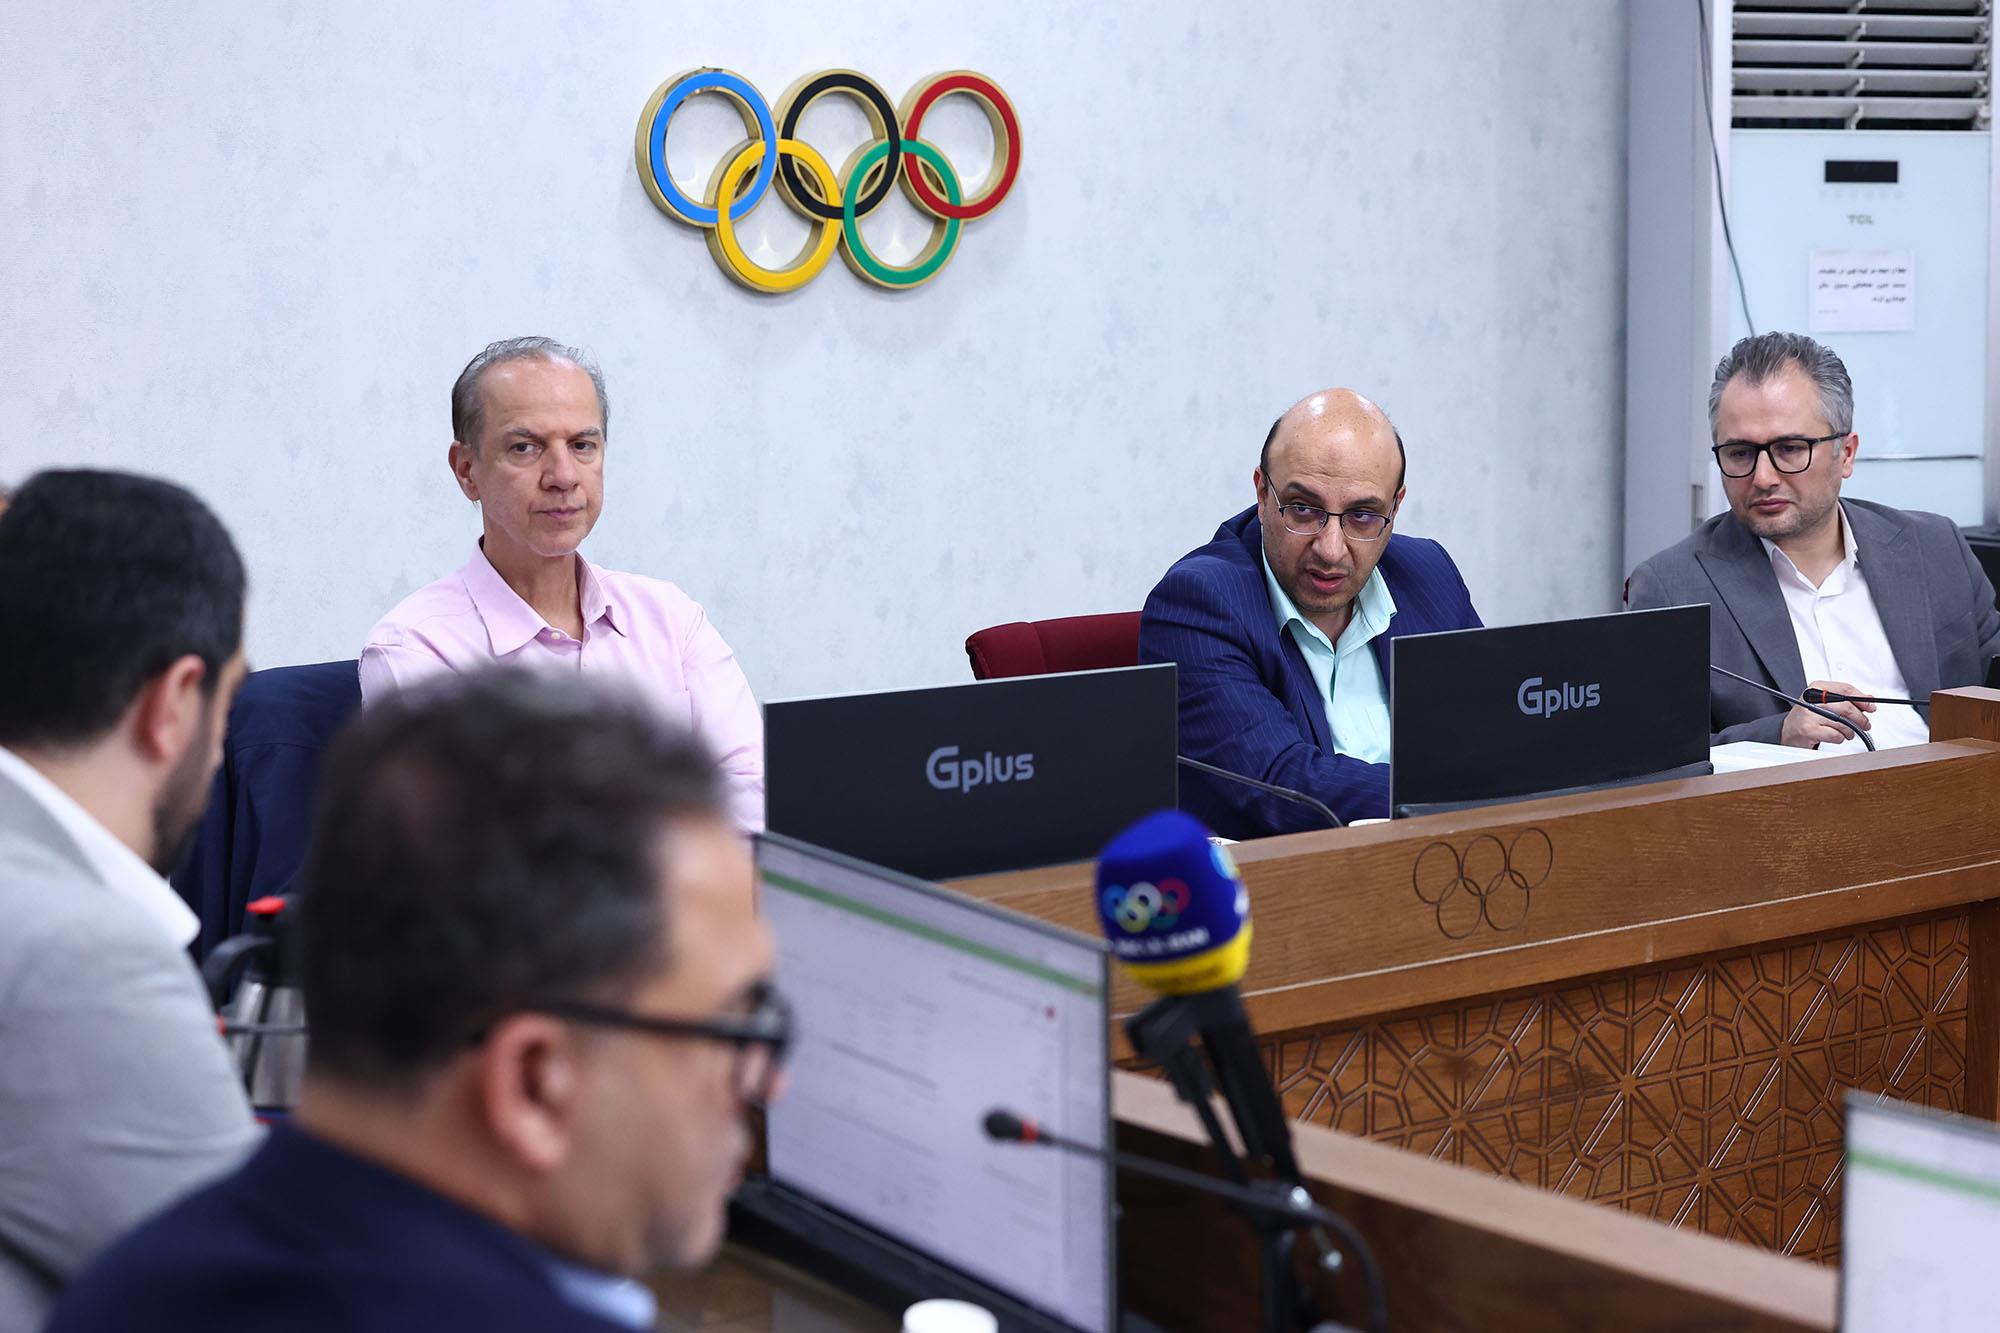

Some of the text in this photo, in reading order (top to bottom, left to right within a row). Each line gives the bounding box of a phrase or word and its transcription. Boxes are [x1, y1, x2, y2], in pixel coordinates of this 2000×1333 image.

[1848, 214, 1875, 225] TCL
[1517, 676, 1601, 719] Gplus
[926, 745, 1035, 794] Gplus
